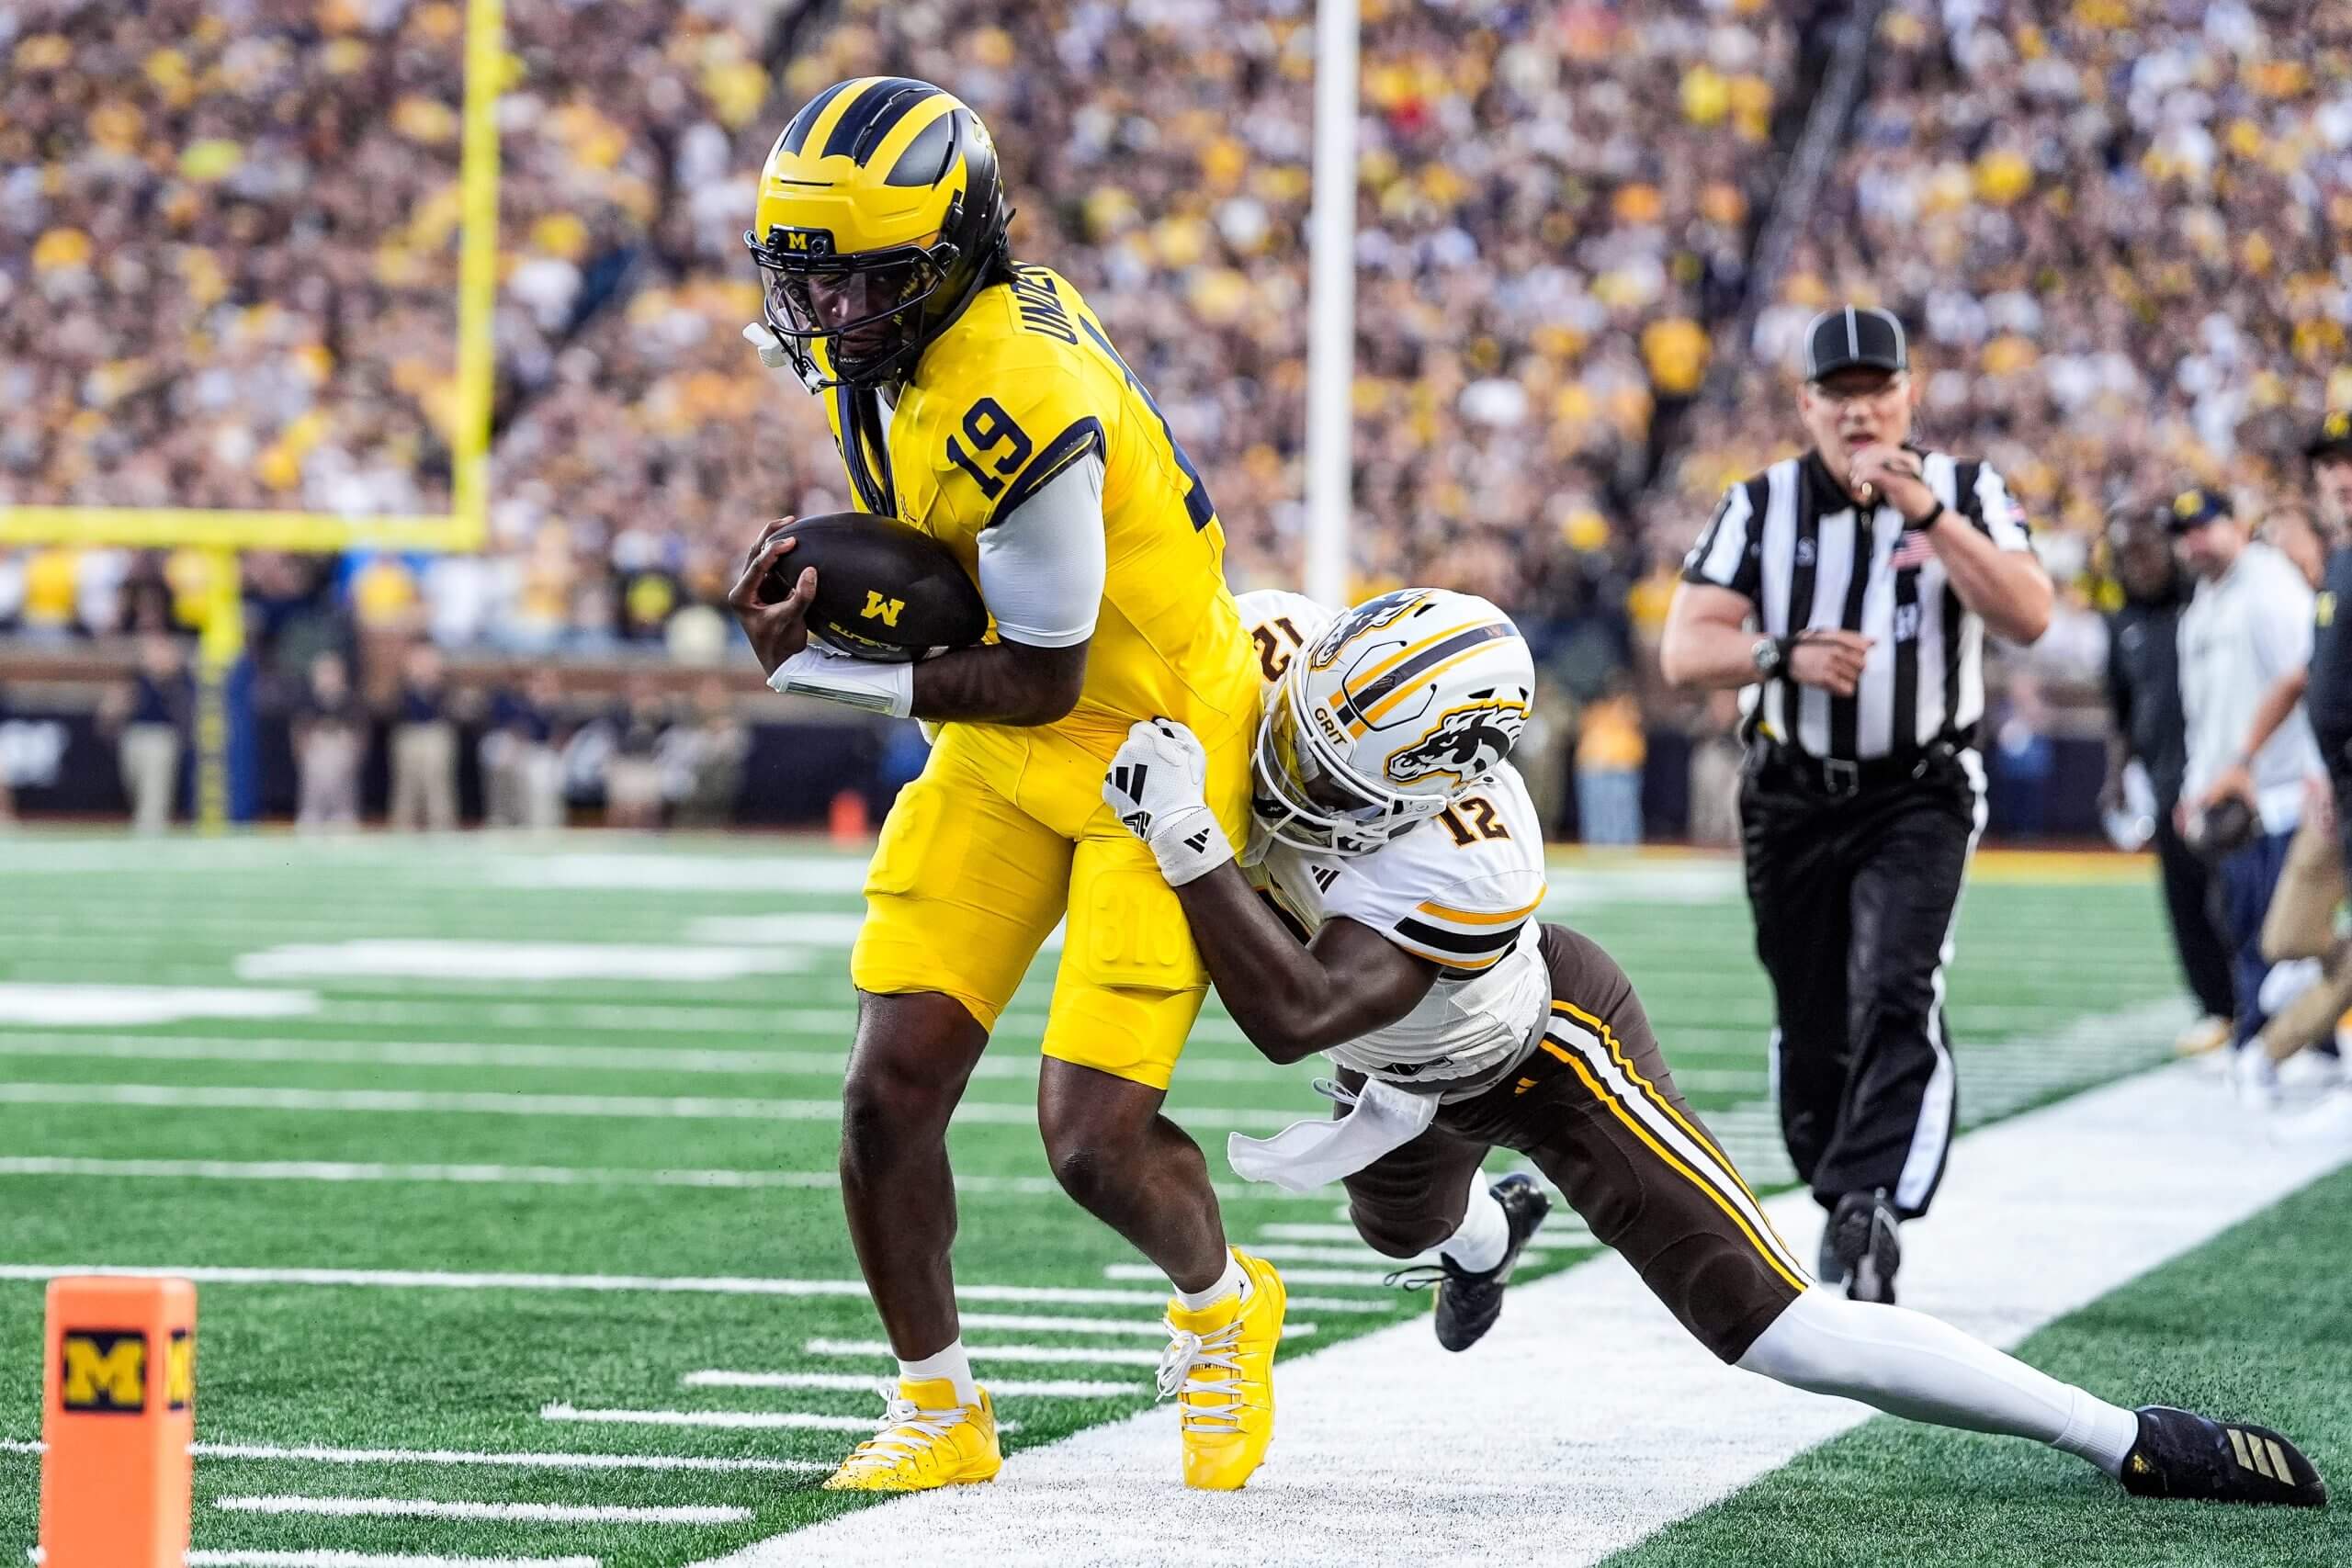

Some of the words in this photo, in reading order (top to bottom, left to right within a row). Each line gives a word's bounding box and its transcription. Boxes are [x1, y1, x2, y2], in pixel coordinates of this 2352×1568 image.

[788, 232, 808, 250] M
[946, 397, 1033, 502] 19
[860, 589, 906, 628] M
[1250, 616, 1305, 682] 12
[1314, 706, 1349, 746] GRIT
[1435, 796, 1512, 848] 12
[64, 1337, 144, 1406] M
